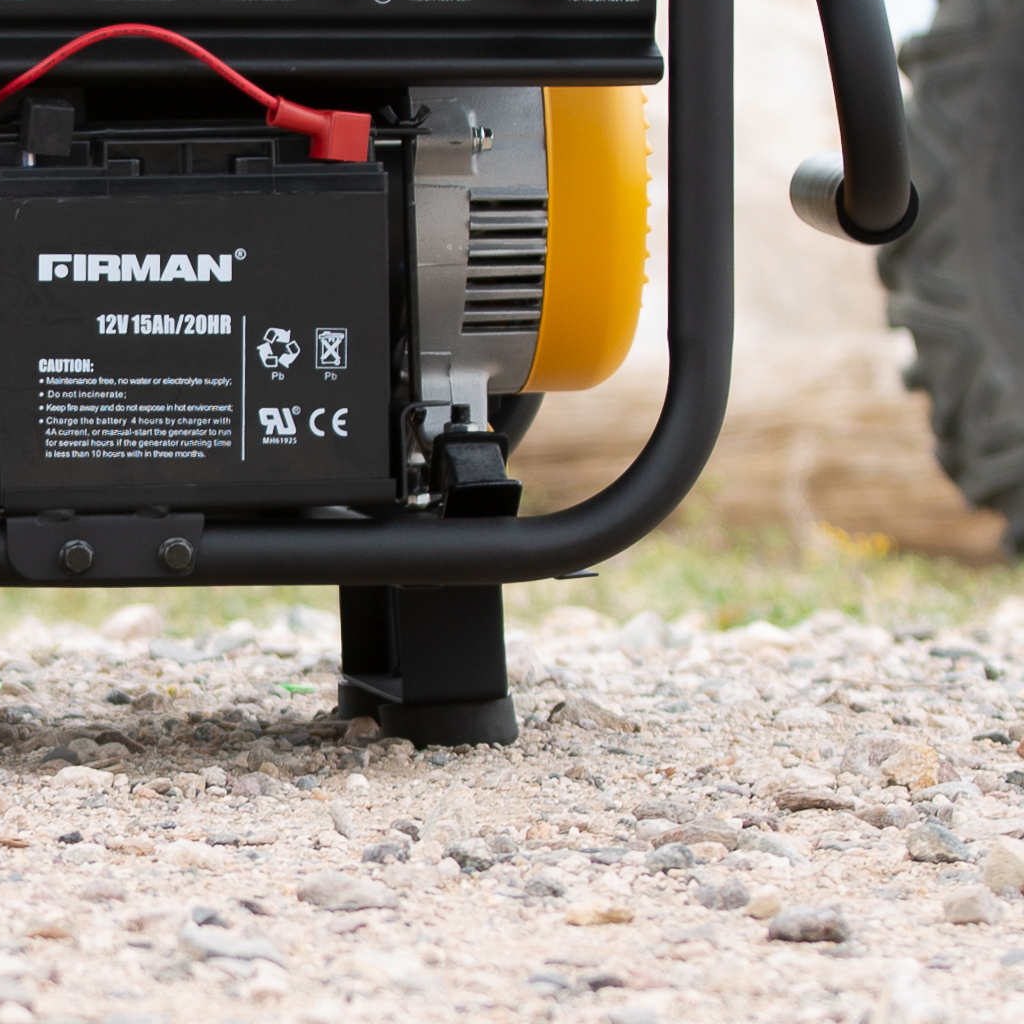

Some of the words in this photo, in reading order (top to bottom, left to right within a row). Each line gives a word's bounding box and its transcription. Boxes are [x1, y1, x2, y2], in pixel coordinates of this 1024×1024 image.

[96, 314, 129, 335] 12V
[131, 314, 232, 335] 15Ah/20HR
[39, 358, 94, 373] CAUTION:
[271, 371, 285, 380] Pb
[324, 371, 337, 380] Pb
[46, 377, 97, 385] Maintenance
[98, 377, 116, 386] free,
[130, 377, 151, 385] water
[163, 377, 203, 387] electrolyte
[47, 390, 60, 398] Do
[62, 390, 77, 398] not
[78, 390, 127, 399] incinerate;
[46, 403, 66, 412] Keep
[100, 403, 114, 412] and
[115, 403, 125, 412] do
[126, 403, 138, 412] not
[139, 405, 165, 413] expose
[166, 403, 173, 412] in
[174, 403, 186, 412] hot
[46, 417, 78, 426] Charge
[80, 417, 94, 425] the
[96, 417, 127, 426] battery
[131, 417, 136, 425] 4
[138, 417, 163, 425] hours
[165, 417, 176, 426] by
[177, 417, 211, 426] charger
[213, 417, 231, 425] with
[309, 407, 349, 437] CE
[168, 429, 207, 437] generator
[45, 439, 57, 447] for
[58, 439, 89, 447] several
[91, 439, 114, 447] hours
[116, 439, 123, 447] if
[124, 439, 137, 447] the
[138, 439, 179, 448] generator
[213, 439, 232, 447] time
[45, 450, 53, 458] is
[54, 450, 70, 458] less
[72, 450, 90, 458] than
[91, 450, 101, 458] 10
[102, 450, 125, 458] hours
[126, 450, 143, 458] with
[144, 450, 152, 458] in
[153, 450, 173, 458] three
